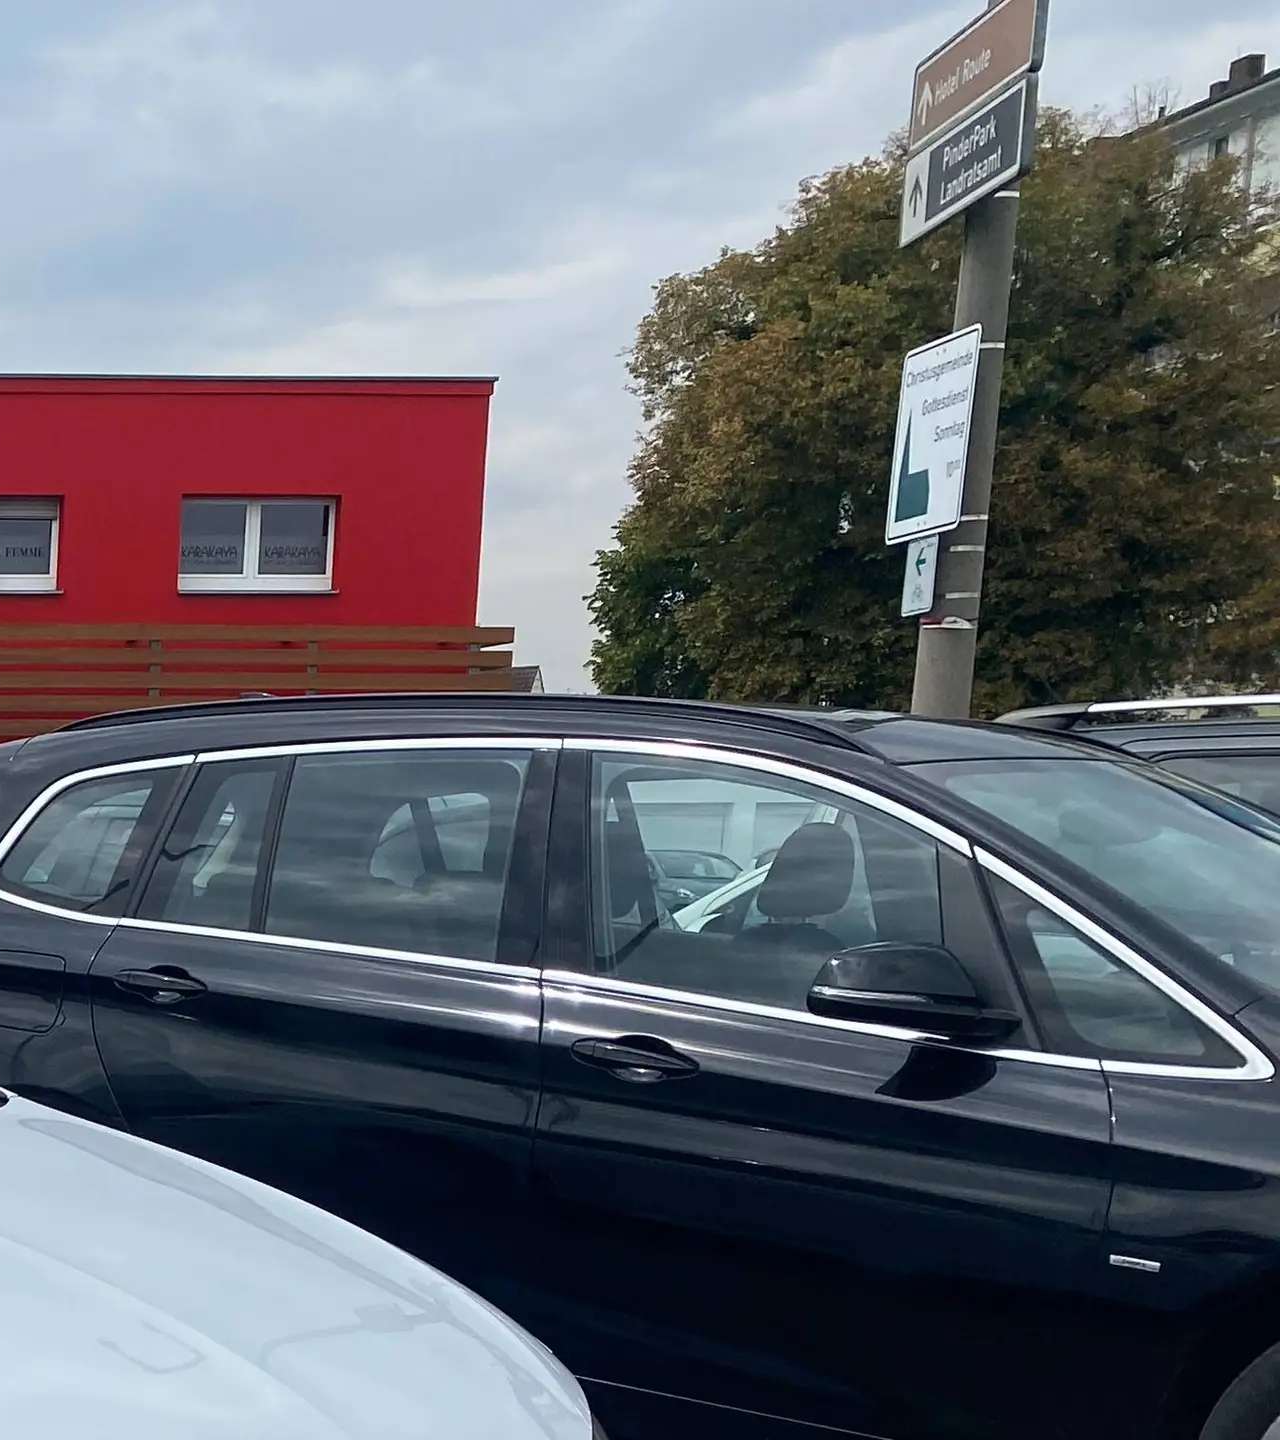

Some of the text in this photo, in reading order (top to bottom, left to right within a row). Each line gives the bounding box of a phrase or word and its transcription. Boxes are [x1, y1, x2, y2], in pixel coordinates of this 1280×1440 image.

[934, 48, 991, 105] Hotel Route
[942, 114, 997, 172] PinderPark
[940, 144, 1002, 205] Landratsamt
[5, 546, 45, 558] FEMME
